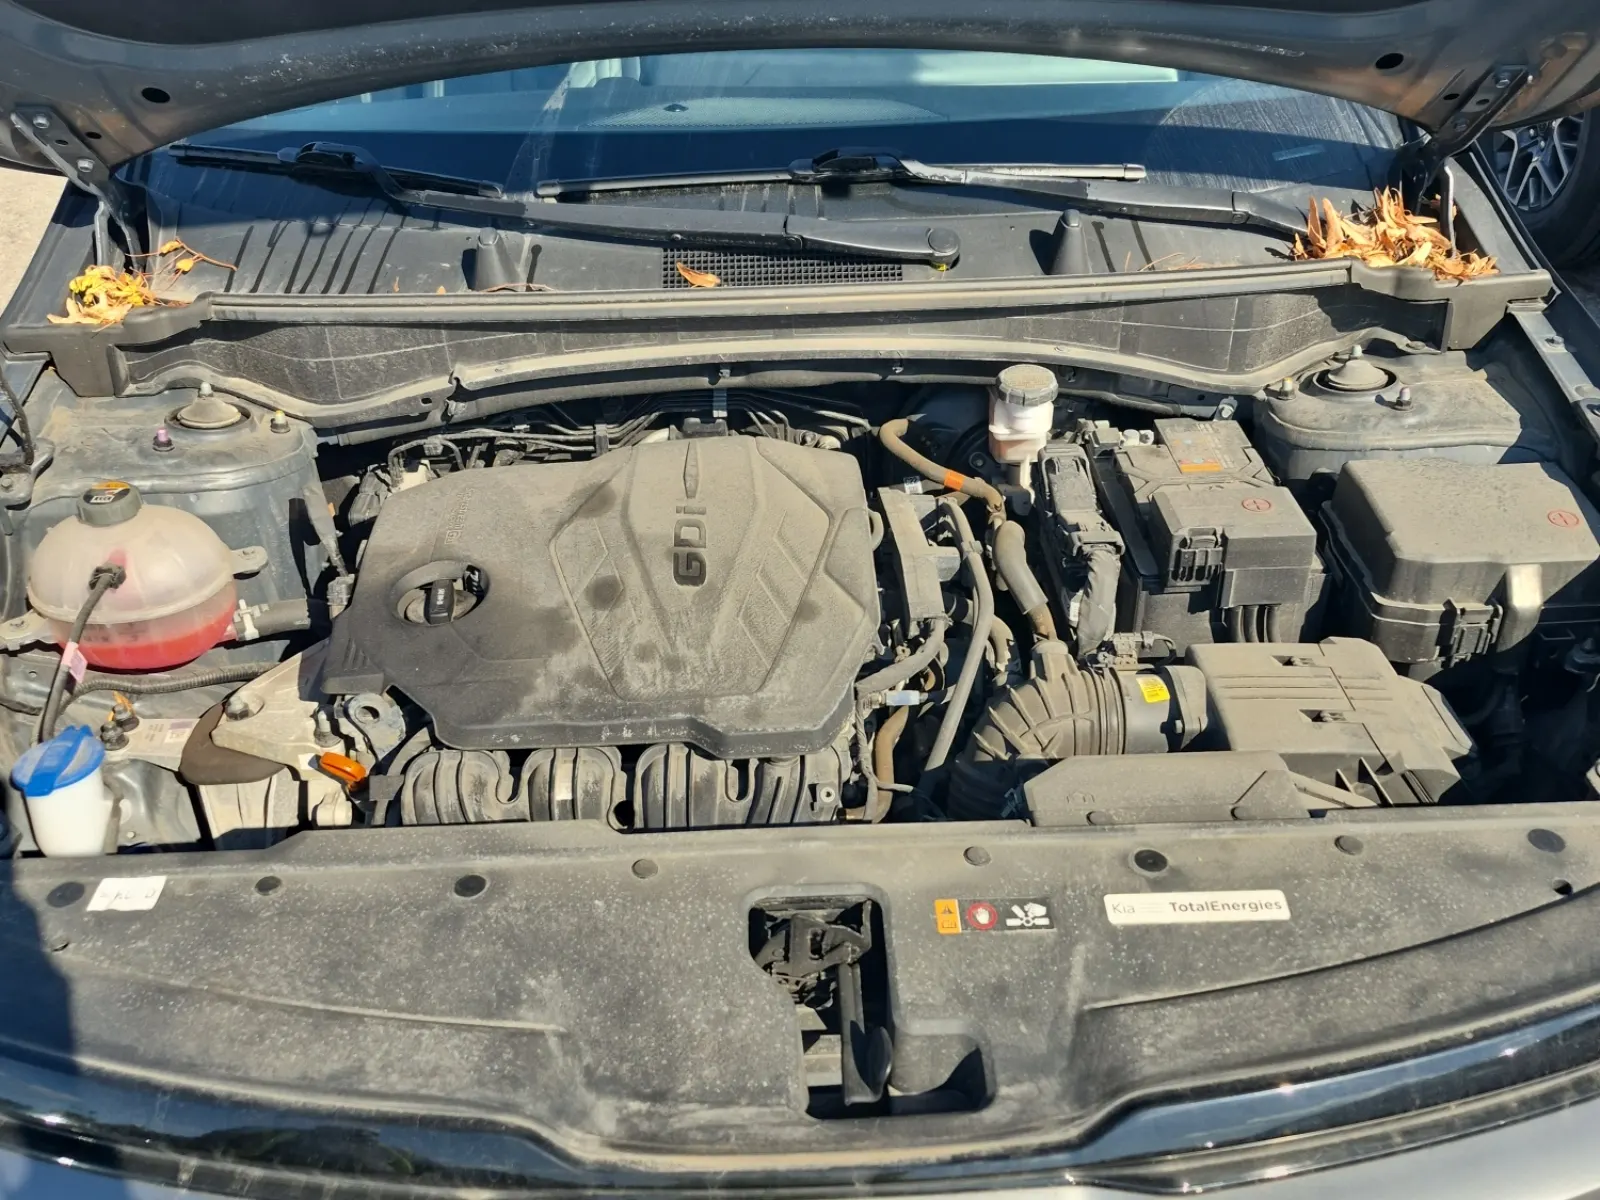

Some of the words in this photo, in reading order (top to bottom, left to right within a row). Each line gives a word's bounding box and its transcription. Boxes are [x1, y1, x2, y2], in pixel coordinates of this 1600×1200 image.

[673, 506, 706, 586] GDi
[1112, 903, 1136, 914] Kia
[1169, 900, 1282, 913] TotalEnergies
